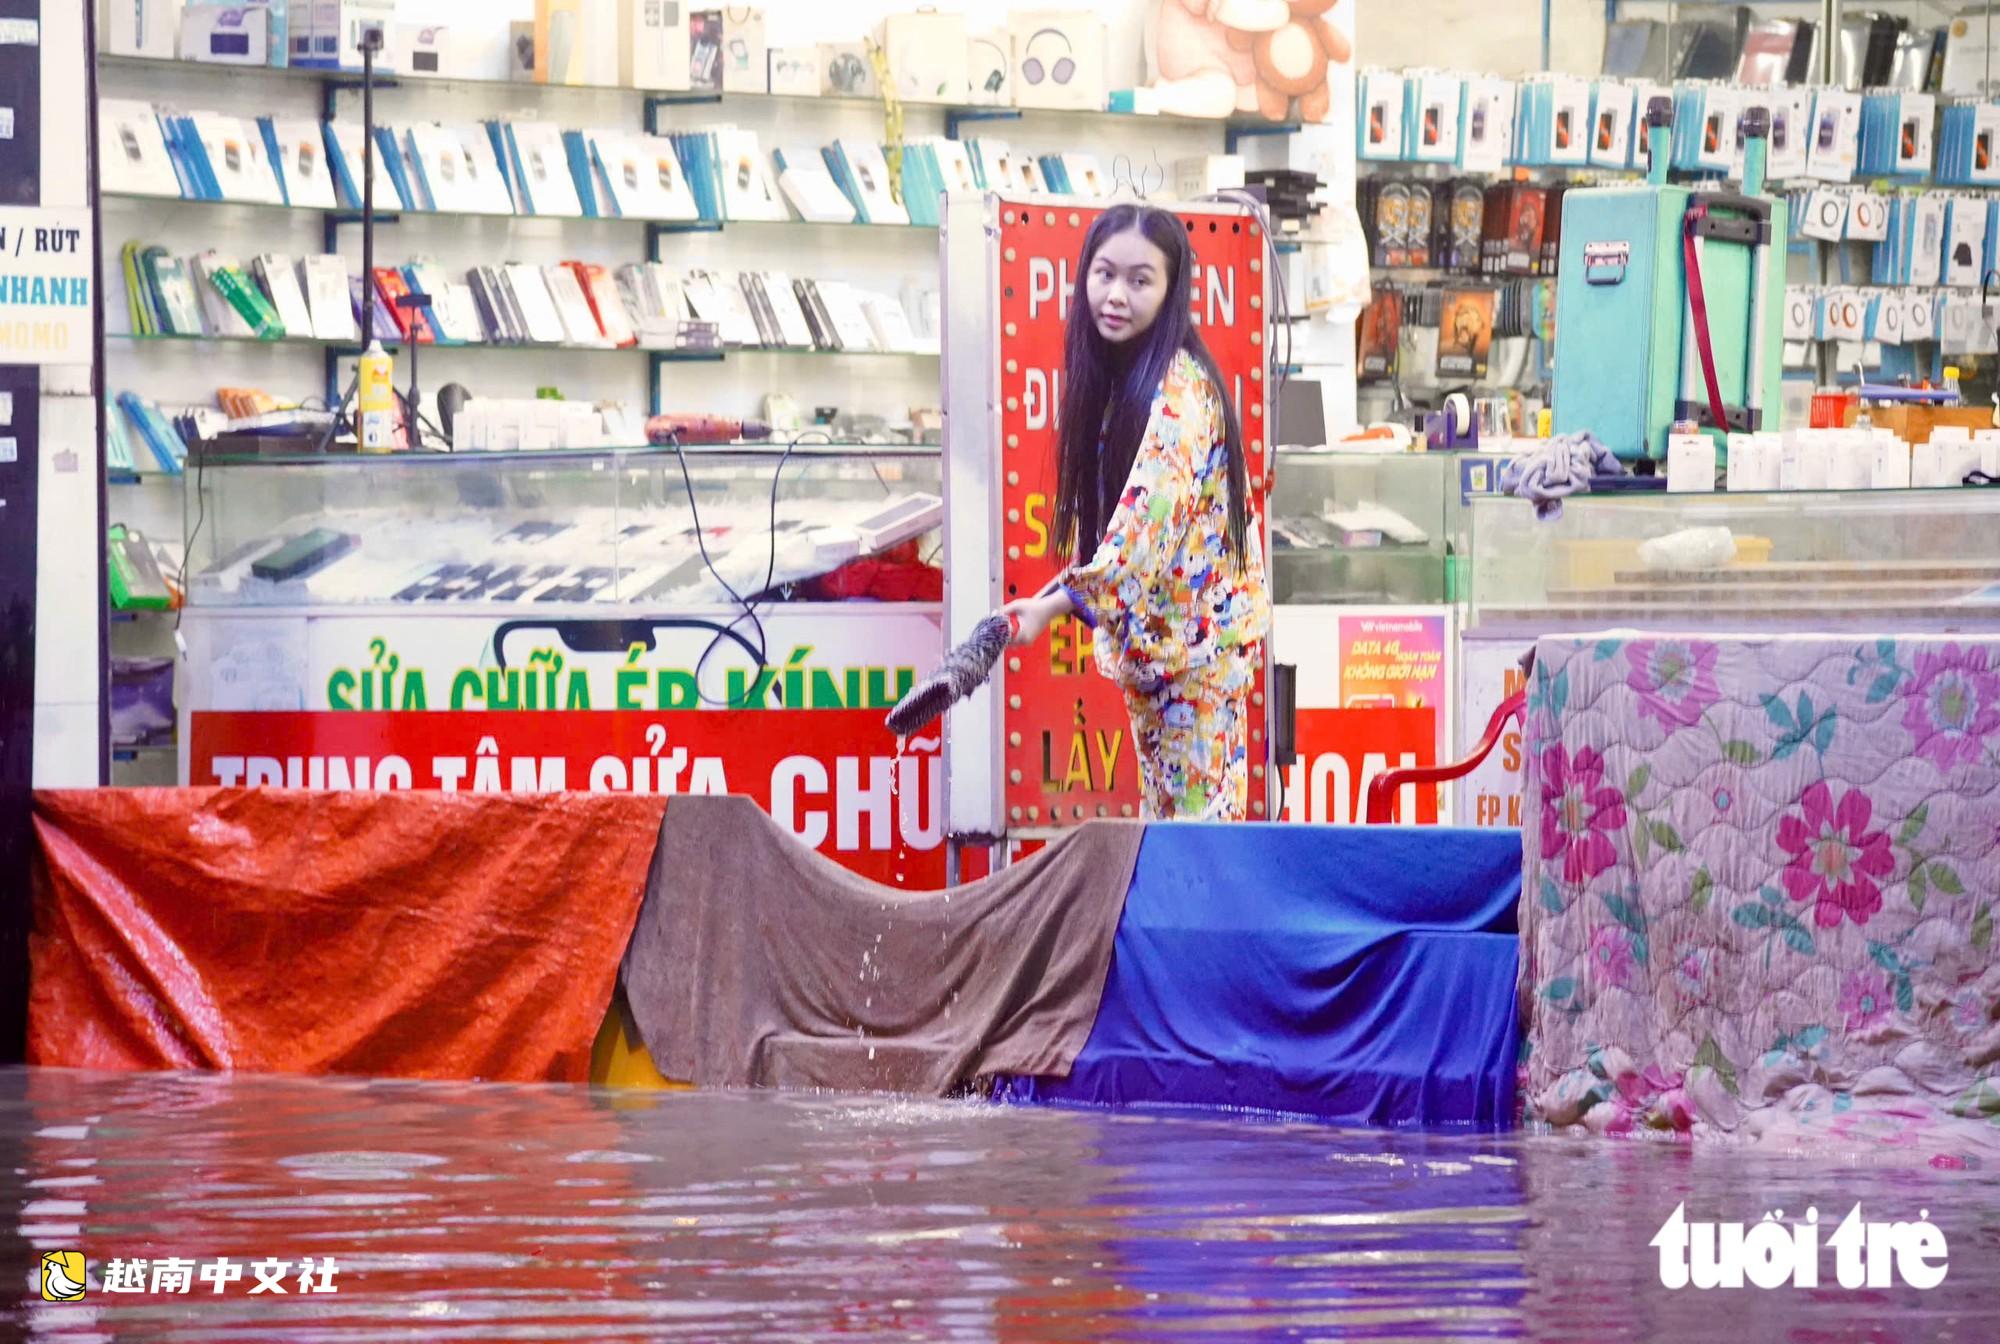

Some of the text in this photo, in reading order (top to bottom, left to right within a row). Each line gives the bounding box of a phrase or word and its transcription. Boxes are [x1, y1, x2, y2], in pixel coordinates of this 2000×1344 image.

[35, 221, 80, 253] RÚT
[1029, 256, 1073, 320] PH
[1352, 641, 1381, 656] DATA
[1344, 662, 1386, 680] KHÔNG
[1412, 665, 1437, 682] HẠN
[1503, 732, 1521, 773] S
[1507, 794, 1522, 827] K
